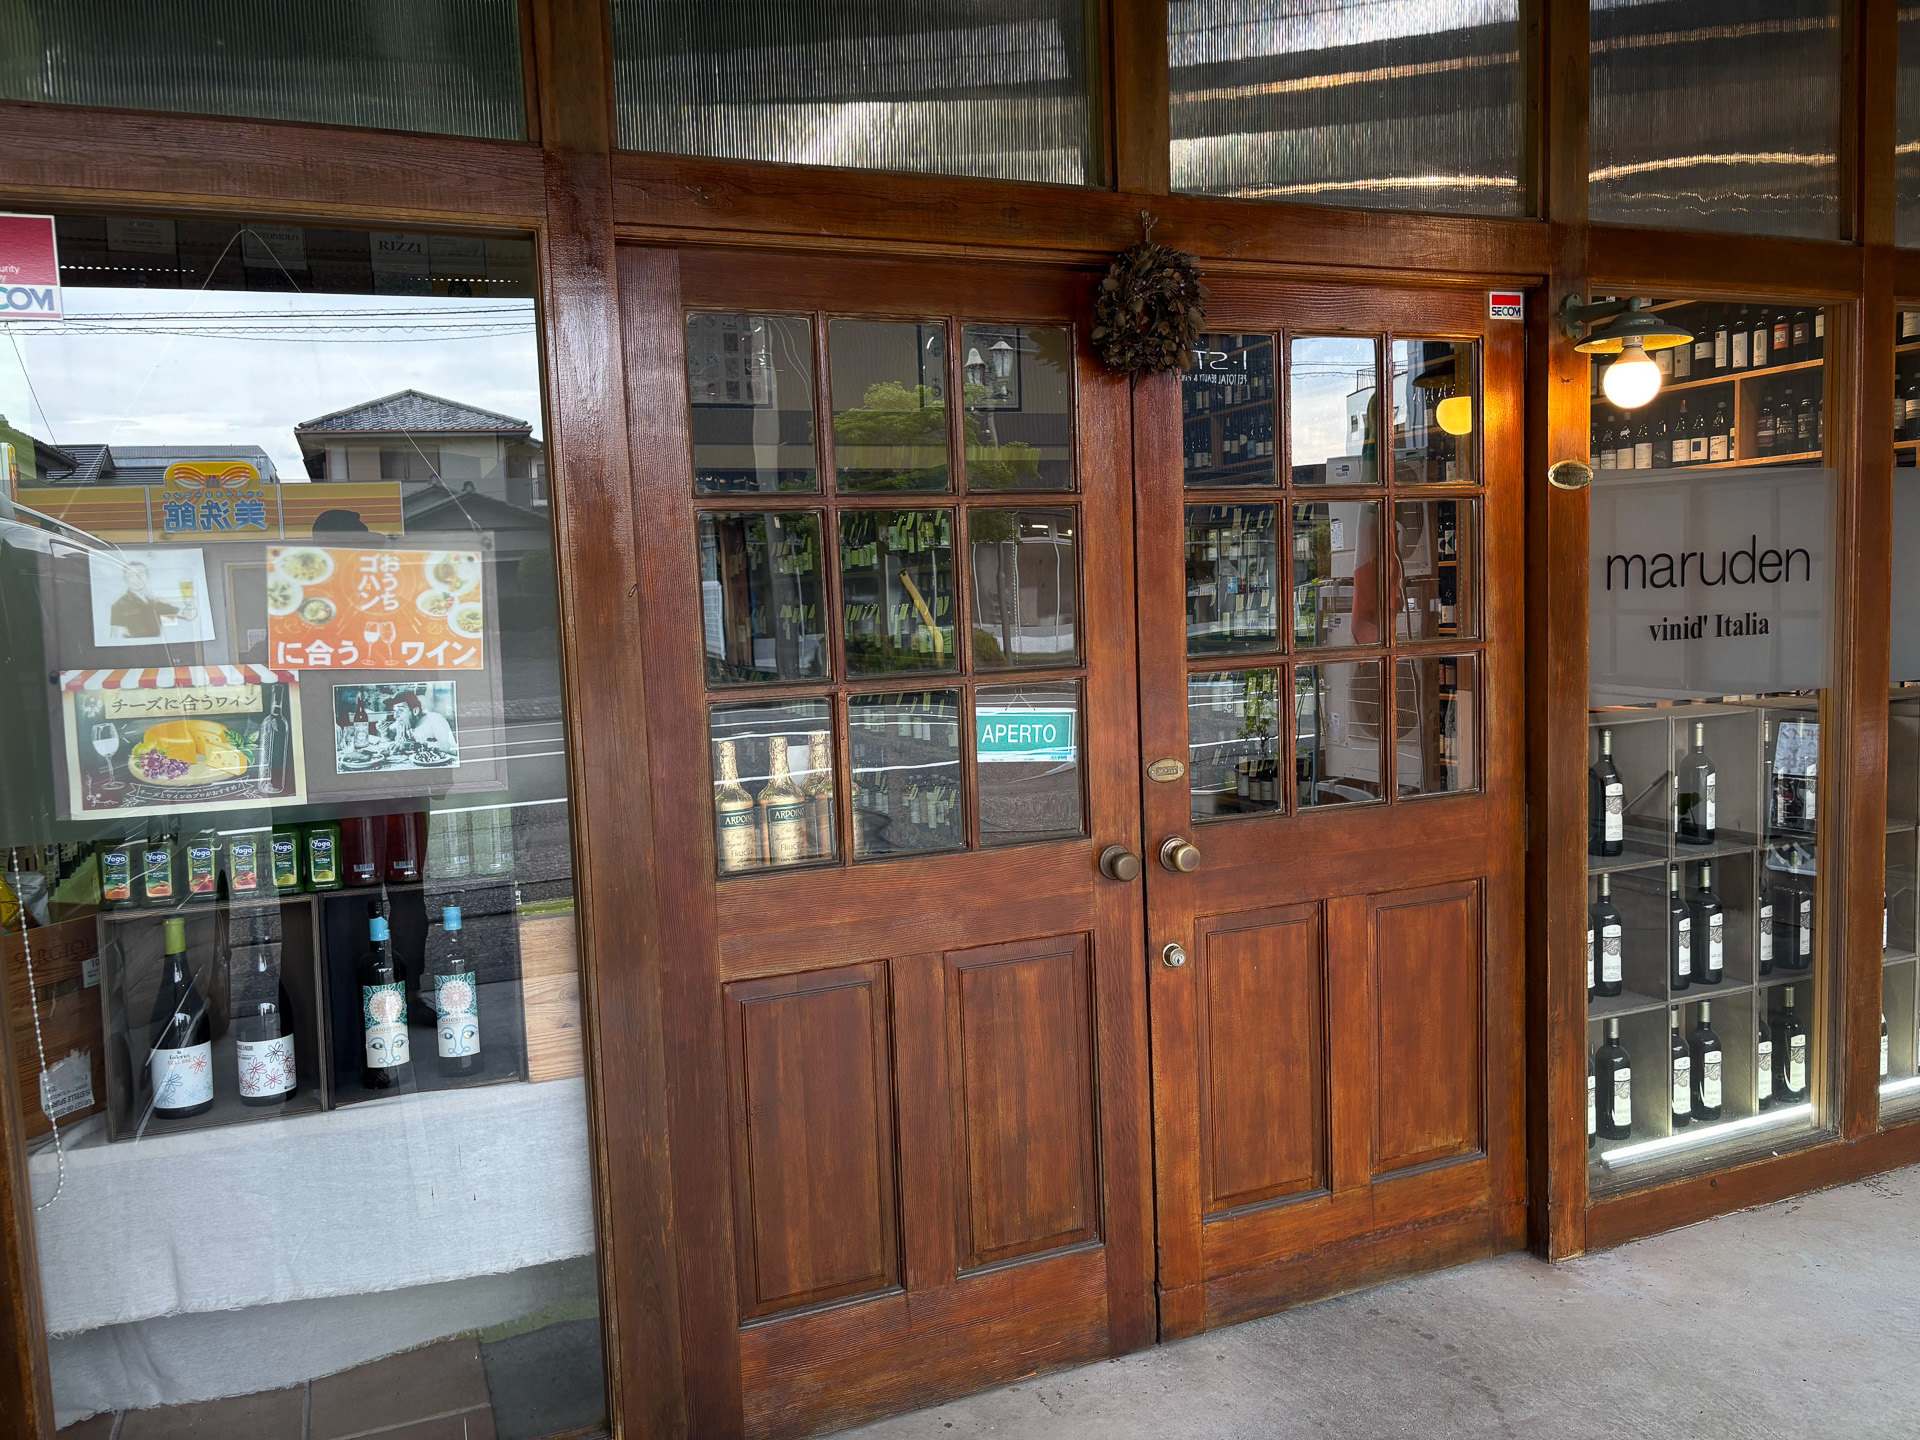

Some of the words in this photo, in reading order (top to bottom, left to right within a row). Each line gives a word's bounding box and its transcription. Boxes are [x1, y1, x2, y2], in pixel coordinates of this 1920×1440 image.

[378, 240, 422, 253] RIZZI
[1491, 306, 1522, 317] SECOM
[1607, 534, 1810, 591] maruden
[358, 553, 380, 611] ゴハン
[380, 553, 400, 611] おうち
[1649, 615, 1708, 642] vinid'
[1714, 611, 1770, 638] Italia
[277, 639, 359, 666] に合う
[401, 639, 477, 666] ワイン
[111, 694, 257, 714] チーズに合うワイン
[981, 724, 1056, 743] APERTO
[234, 846, 253, 856] Yoga
[273, 843, 292, 853] Yoga
[313, 840, 331, 849] Yoga
[106, 855, 125, 864] Yoga
[148, 853, 167, 862] Yoga
[192, 848, 211, 858] Yoga
